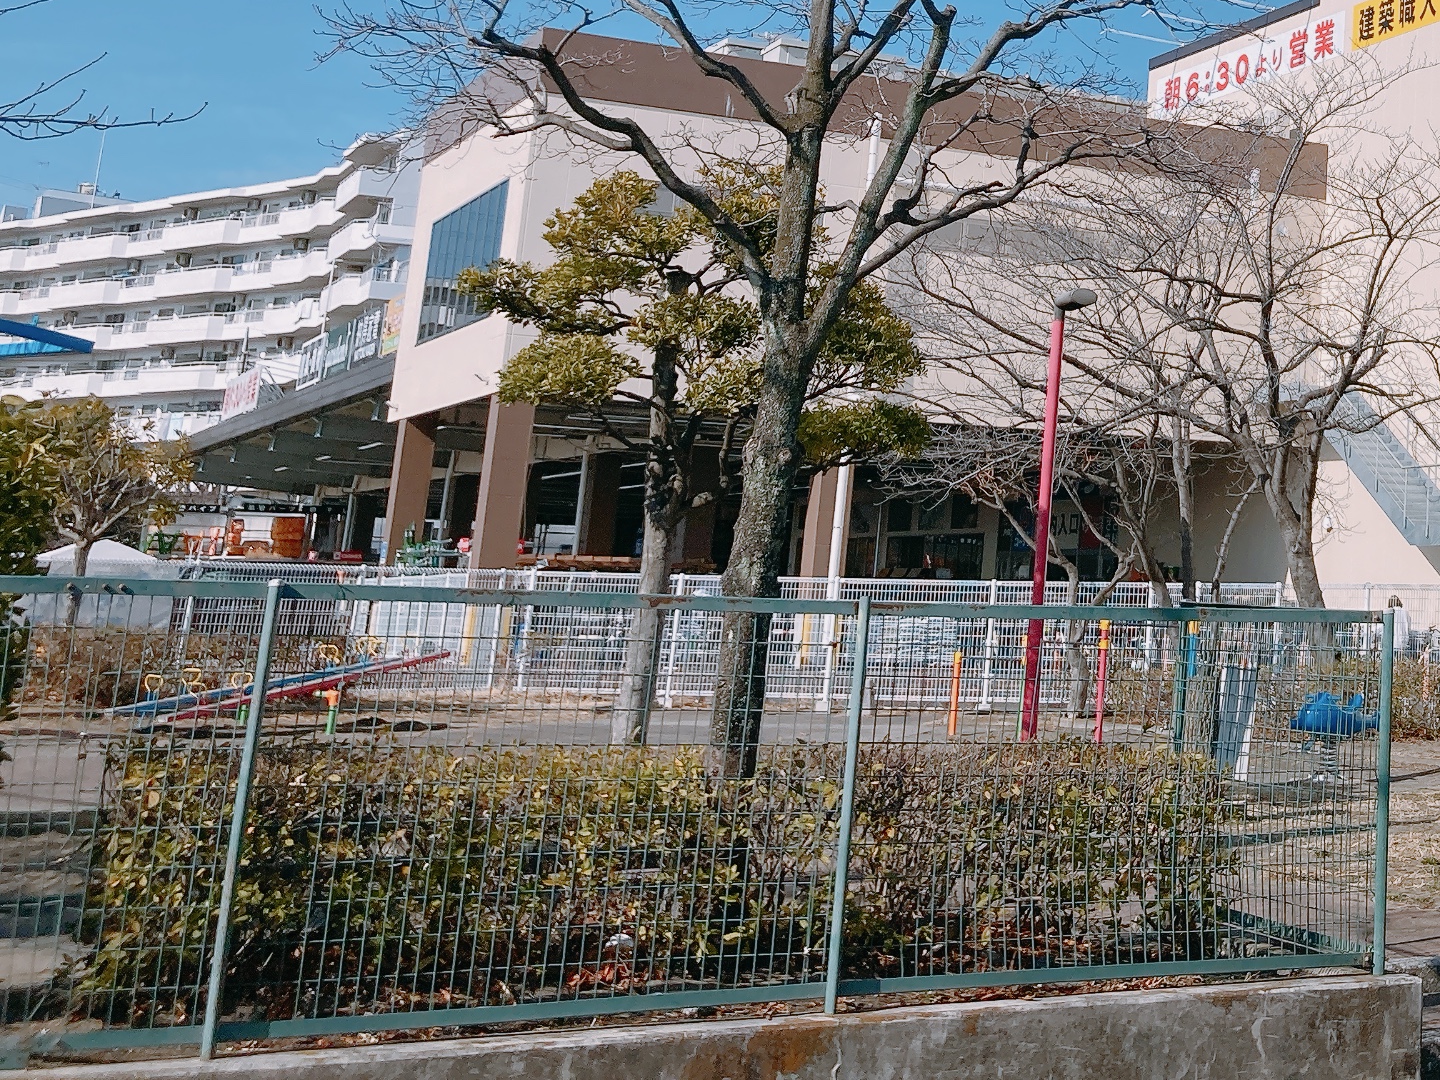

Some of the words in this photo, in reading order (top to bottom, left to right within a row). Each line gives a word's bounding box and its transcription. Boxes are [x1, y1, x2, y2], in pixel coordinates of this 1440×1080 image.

[1164, 18, 1335, 111] 朝6:30より営業
